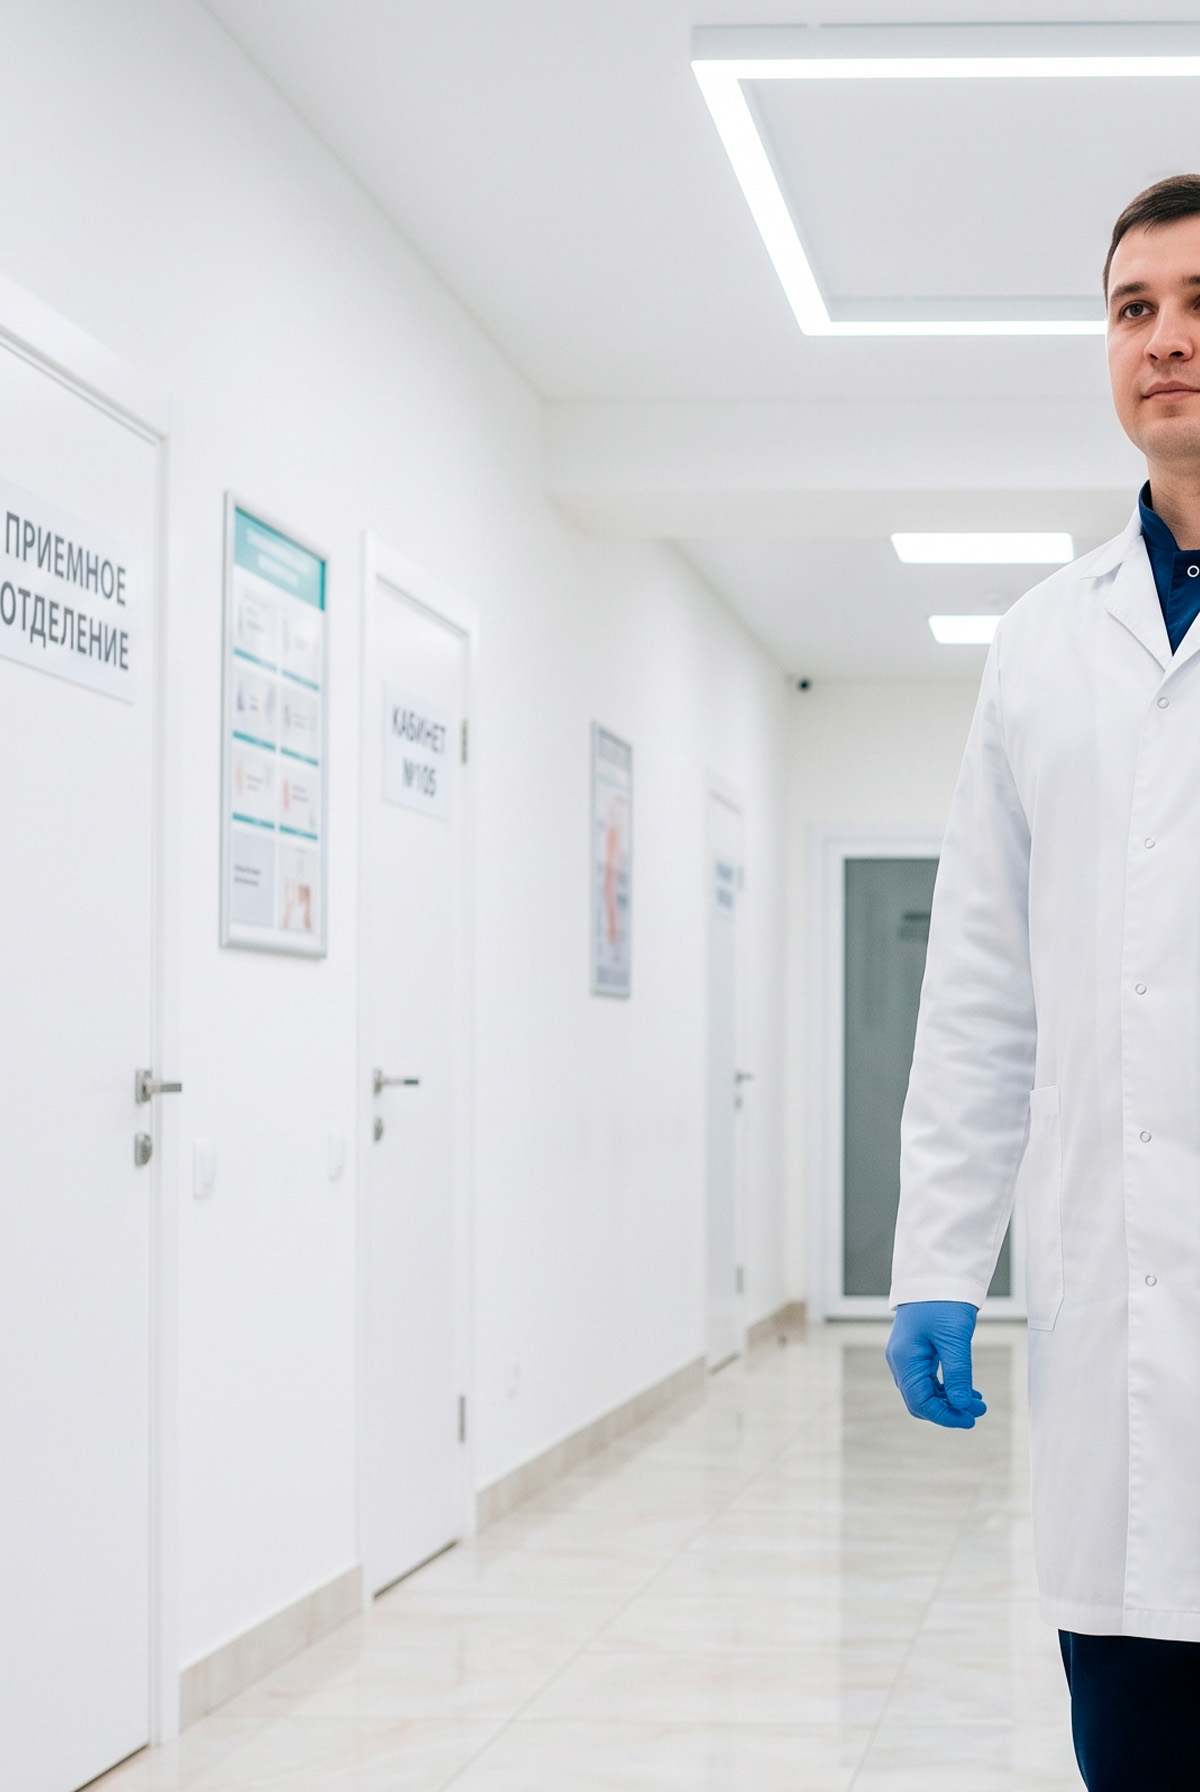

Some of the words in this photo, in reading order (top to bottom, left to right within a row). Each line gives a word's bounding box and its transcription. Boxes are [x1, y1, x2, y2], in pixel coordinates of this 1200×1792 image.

[5, 510, 127, 607] ПРИЕМНОЕ
[0, 580, 129, 671] ОТДЕЛЕНИЕ
[391, 703, 446, 755] КАБИНЕТ
